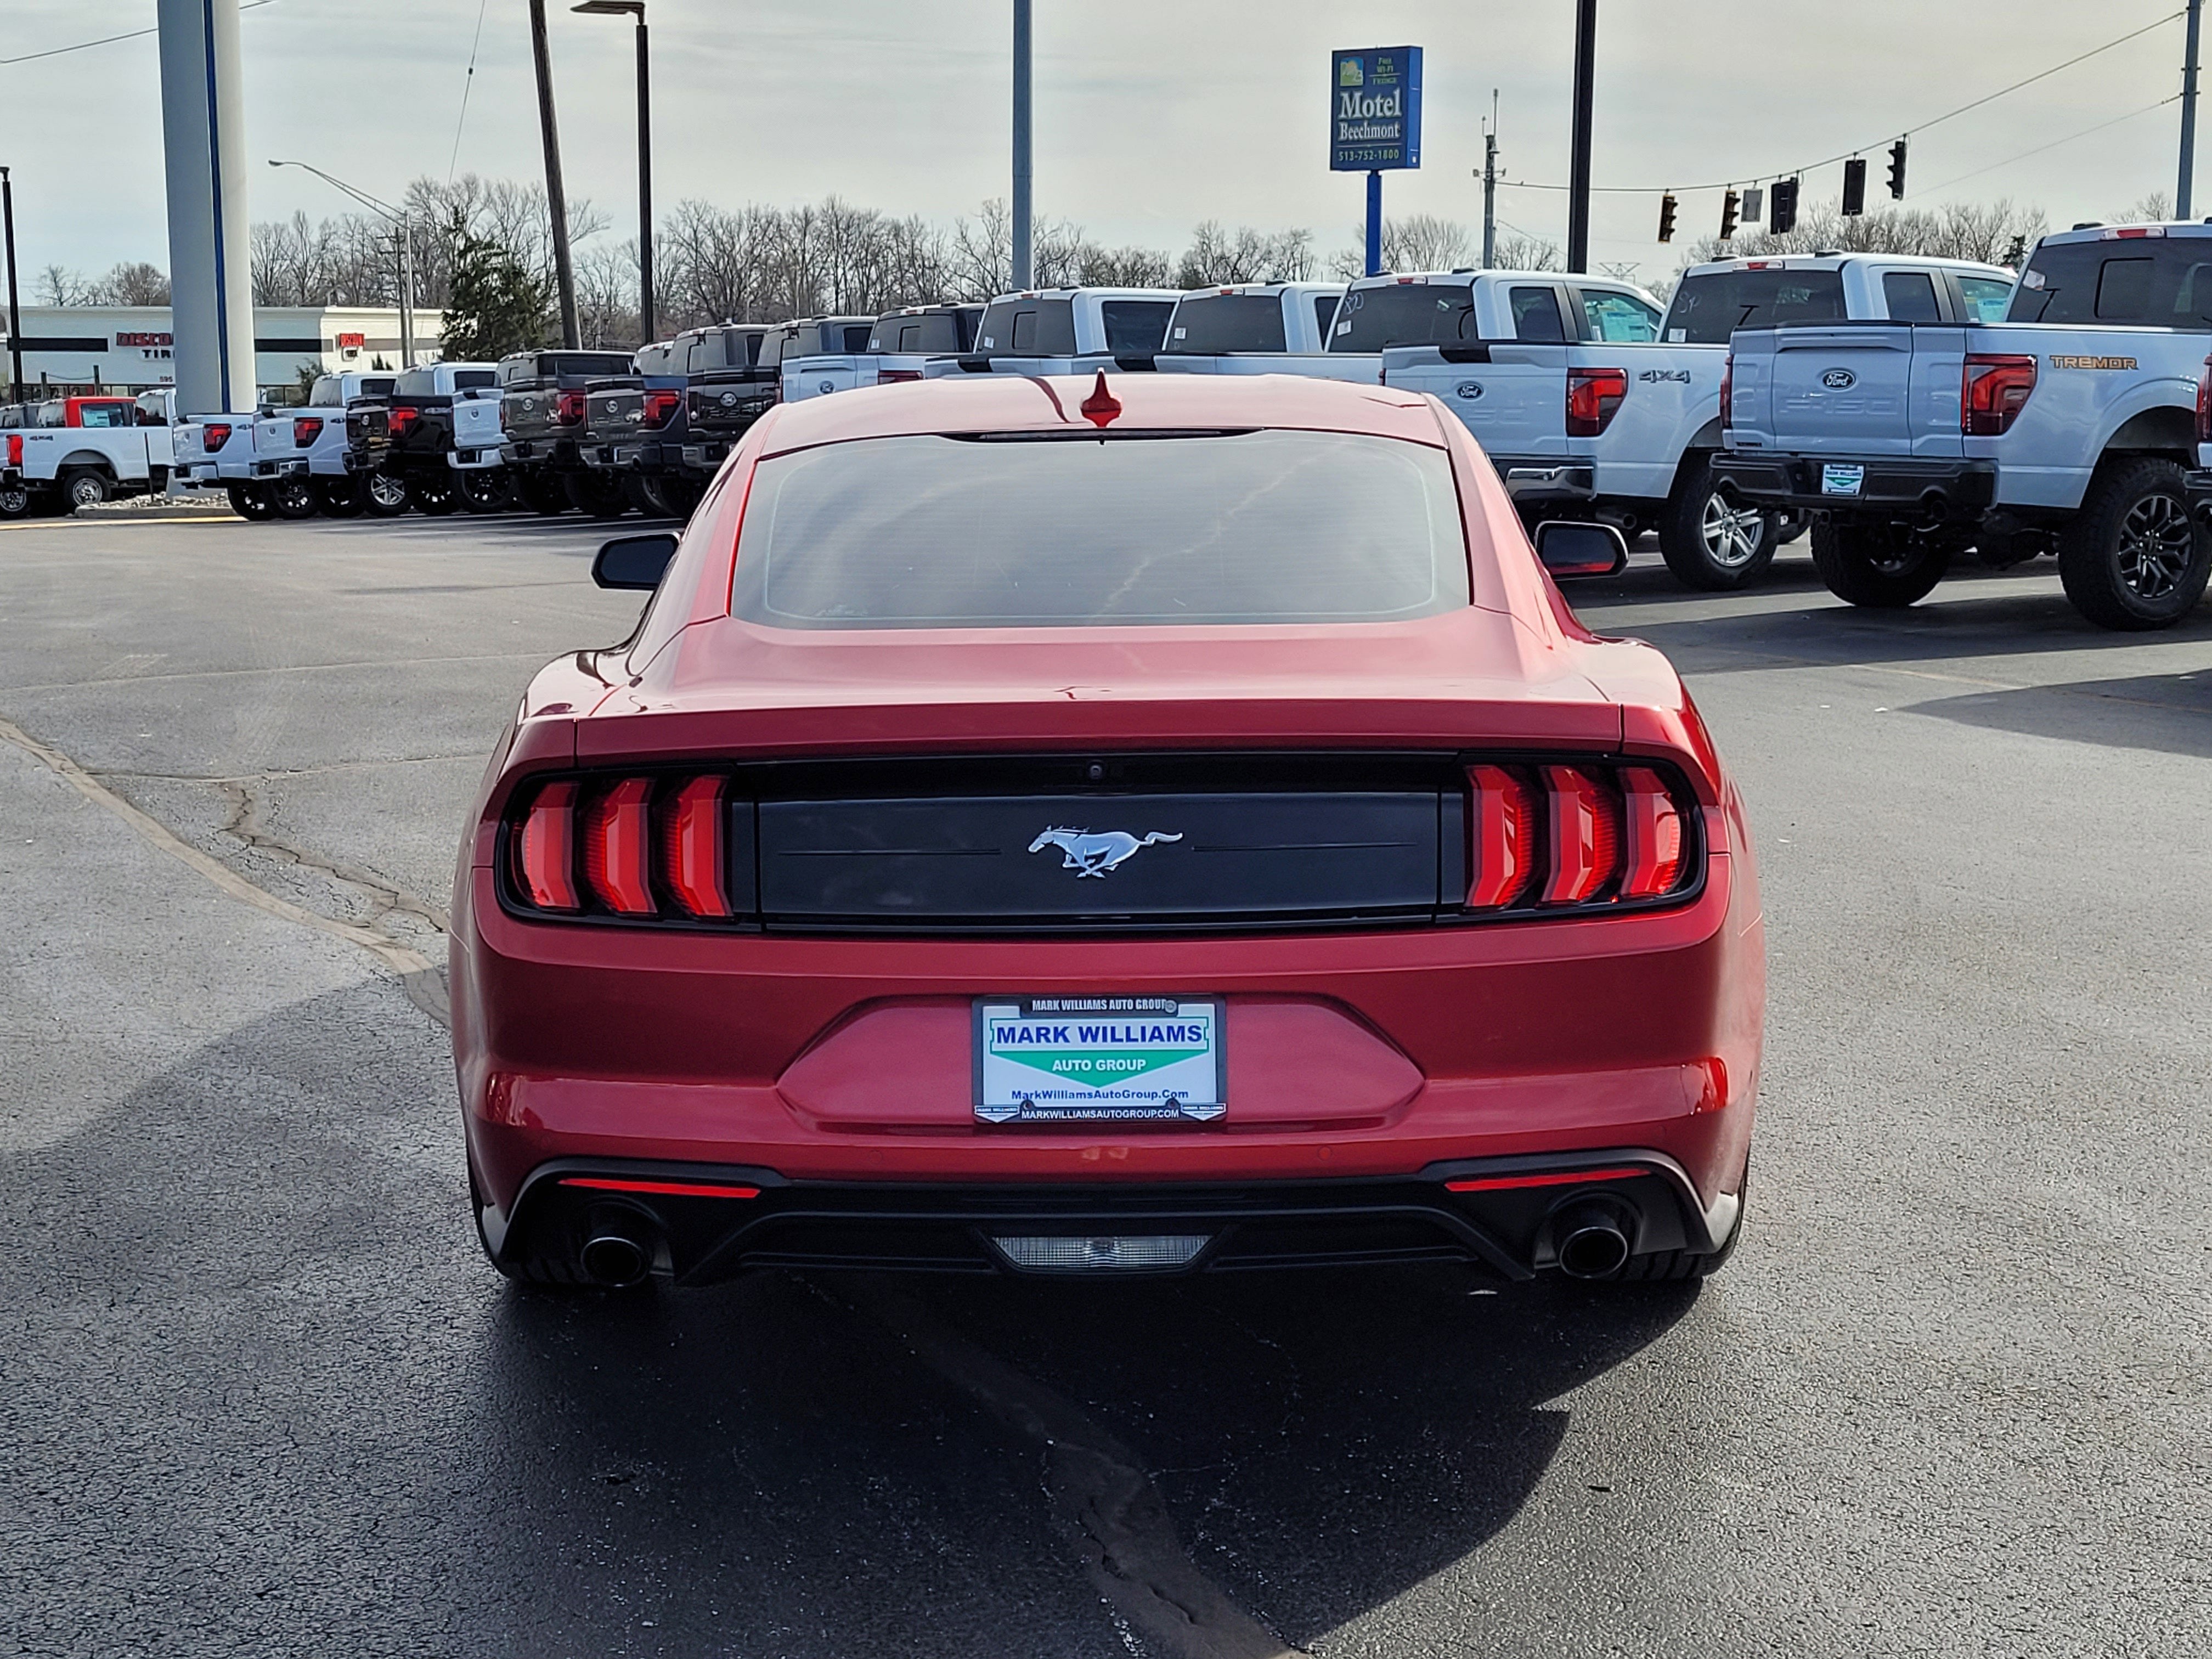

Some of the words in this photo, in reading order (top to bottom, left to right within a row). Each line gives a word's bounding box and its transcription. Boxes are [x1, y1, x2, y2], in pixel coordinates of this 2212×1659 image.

[1338, 87, 1402, 119] Motel
[1338, 120, 1400, 141] Beechmont
[116, 332, 173, 346] DISCO
[142, 349, 175, 358] TIR
[2049, 355, 2138, 370] TREMOR
[1825, 373, 1851, 387] Ford
[1032, 1000, 1060, 1011] MARK
[1061, 999, 1108, 1011] WILLIAMS
[1109, 998, 1133, 1010] AUTO
[997, 1026, 1070, 1043] MARK
[1078, 1024, 1202, 1043] WILLIAMS
[1052, 1059, 1092, 1071] AUTO
[1095, 1059, 1147, 1071] GROUP
[1012, 1089, 1189, 1101] MarkWilliamsAutoGroup.Com
[1021, 1109, 1180, 1120] MARKWILLIAMSAUTOGROUP.COM
